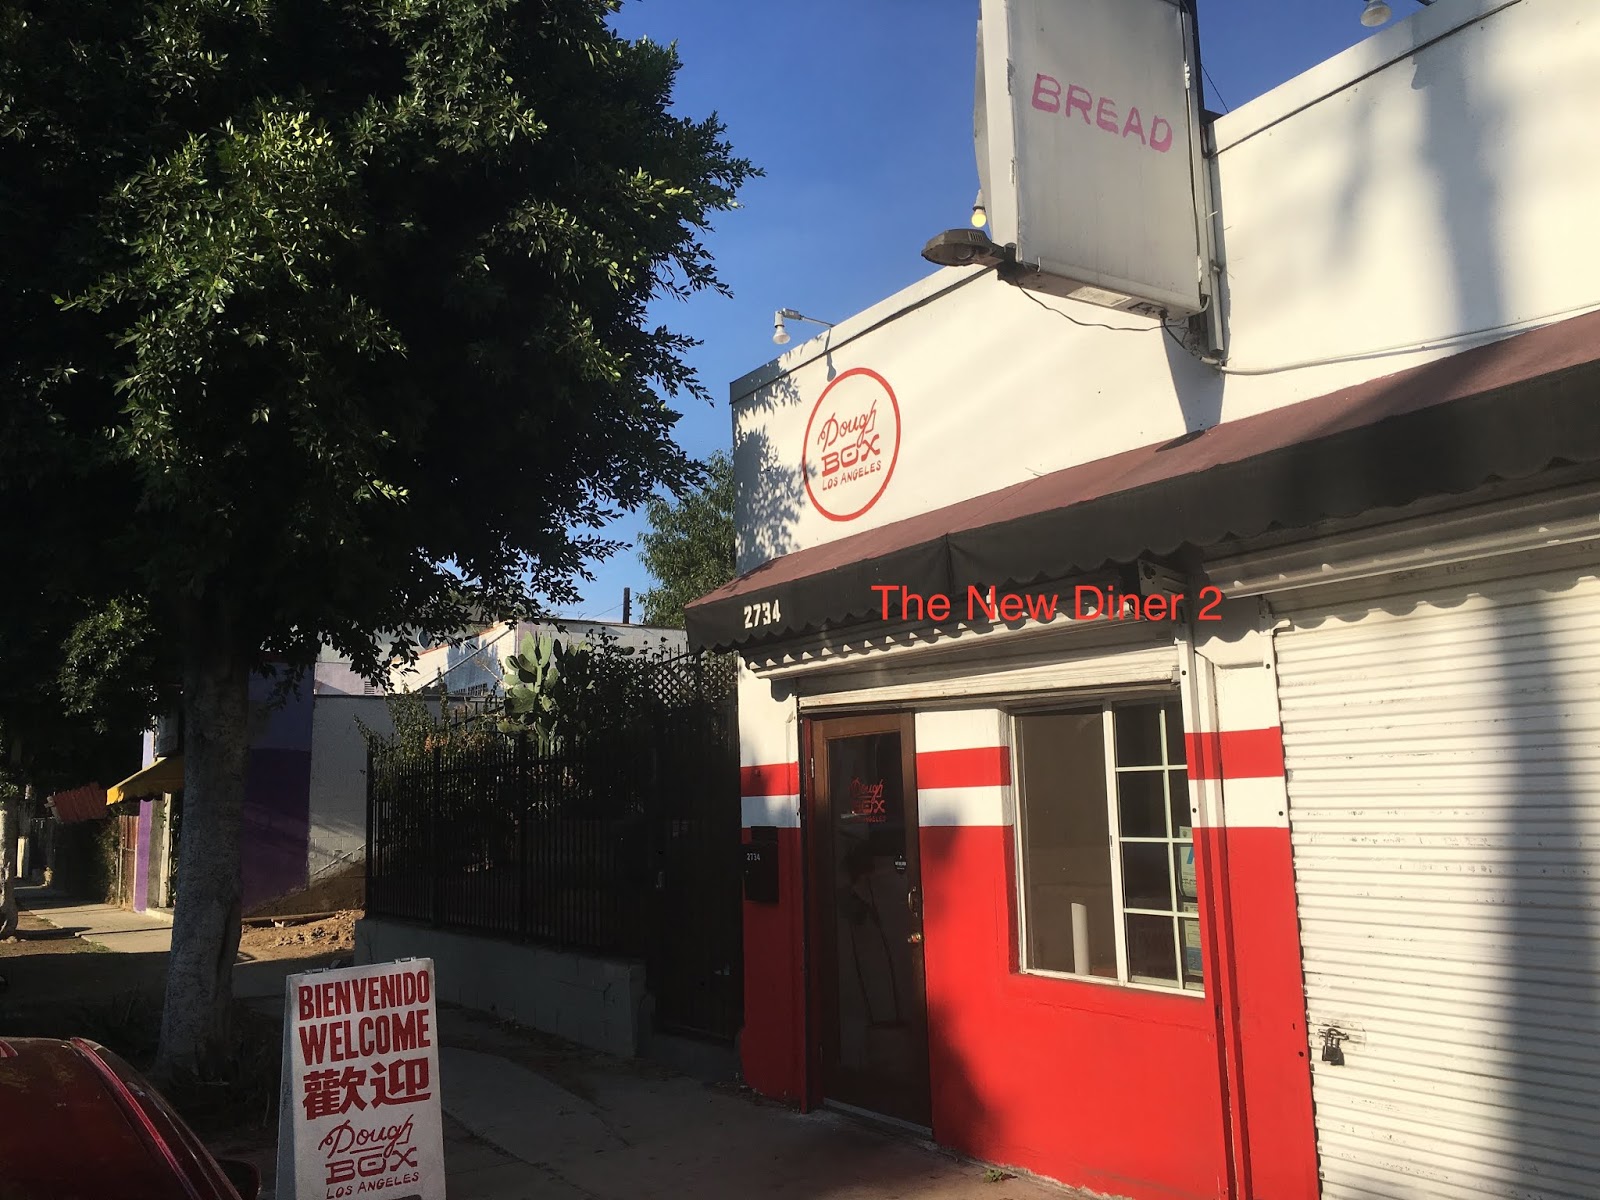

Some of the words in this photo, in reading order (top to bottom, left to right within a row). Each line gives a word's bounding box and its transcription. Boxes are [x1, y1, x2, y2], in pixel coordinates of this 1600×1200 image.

[1032, 73, 1173, 153] BREAD
[817, 399, 877, 453] Dough
[821, 434, 881, 477] BOX
[822, 476, 838, 491] LOS
[840, 460, 882, 485] ANGELES
[743, 599, 781, 629] 2734
[746, 852, 761, 861] 2734
[298, 970, 430, 1021] BIENVENIDO
[298, 1009, 431, 1066] WELCOME
[302, 1057, 431, 1120] 歡迎
[318, 1113, 414, 1159] Dough
[325, 1146, 418, 1185] BOX
[326, 1181, 353, 1200] LOS
[357, 1172, 419, 1193] ANGELES
